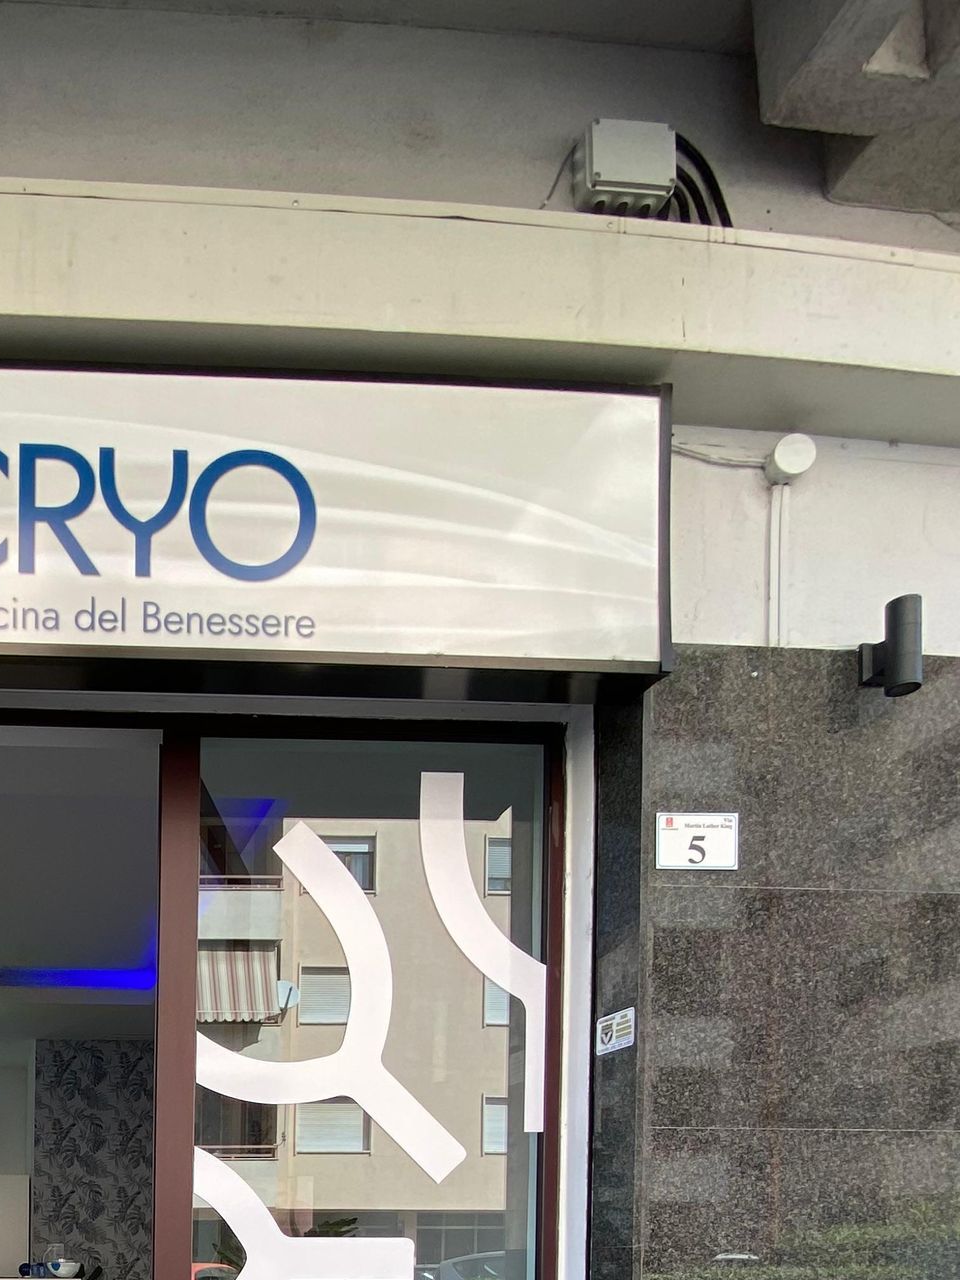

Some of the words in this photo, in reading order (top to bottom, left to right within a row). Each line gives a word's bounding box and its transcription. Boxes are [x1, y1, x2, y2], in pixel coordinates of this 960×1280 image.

[74, 597, 127, 634] del
[143, 601, 317, 639] Benessere
[688, 835, 706, 864] 5
